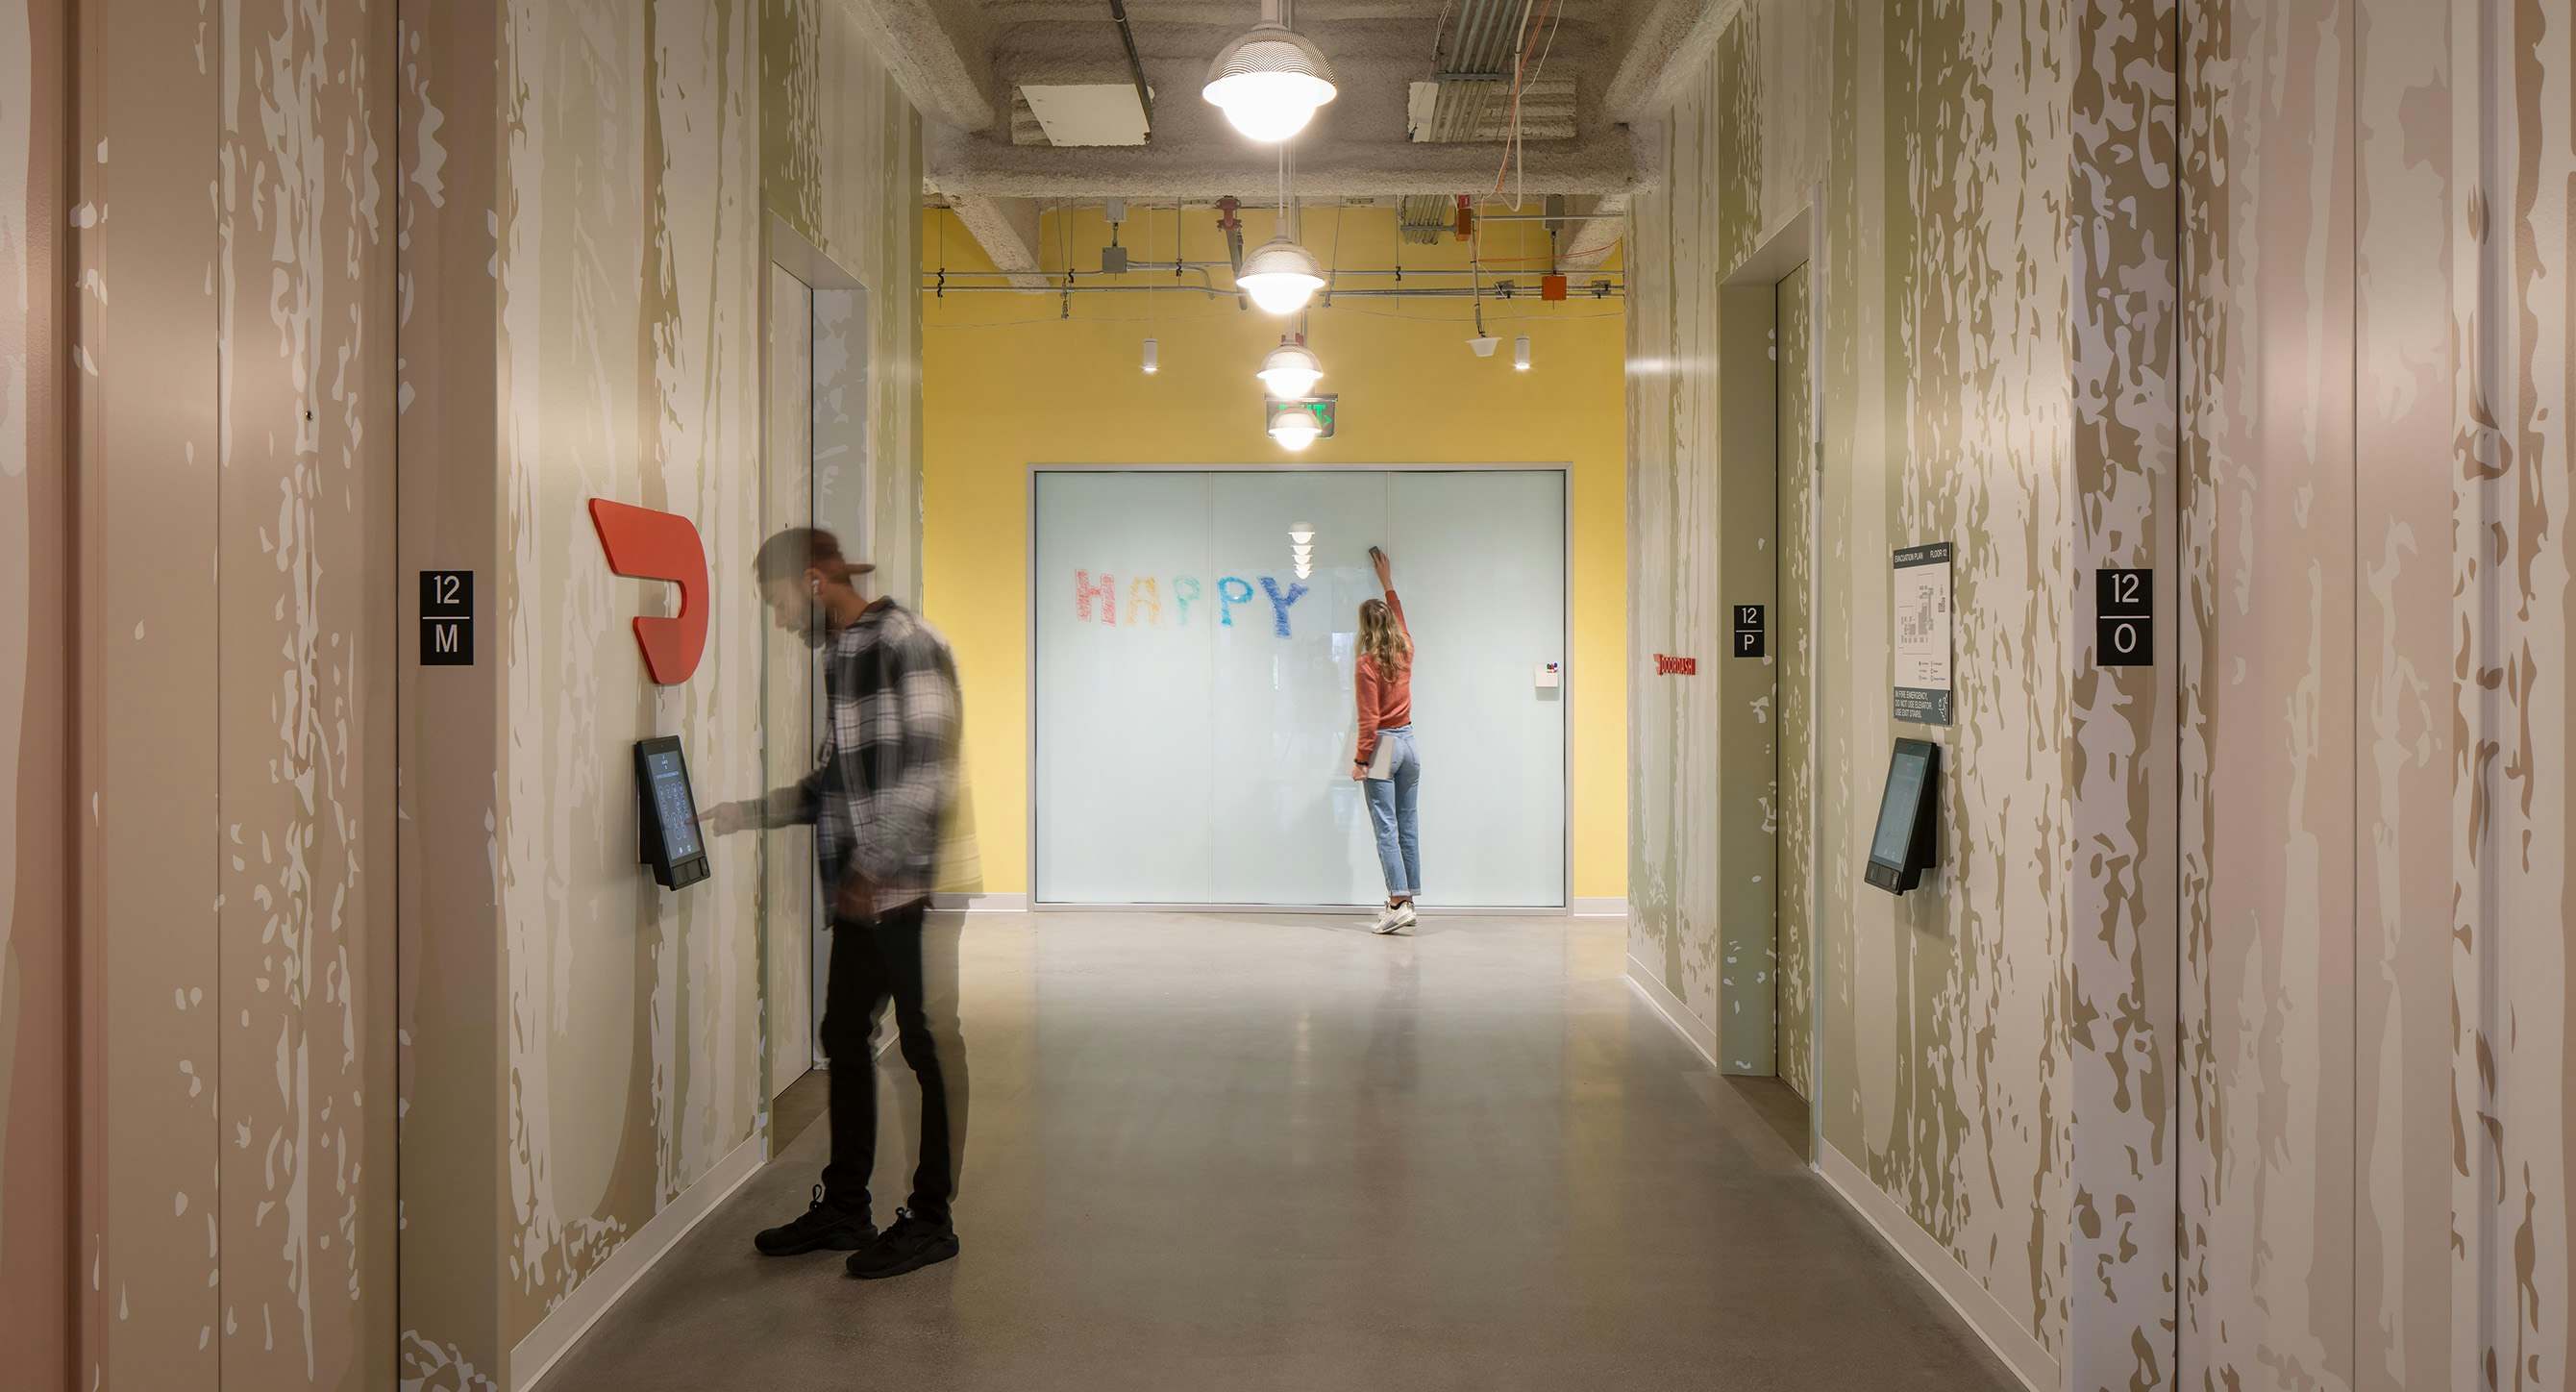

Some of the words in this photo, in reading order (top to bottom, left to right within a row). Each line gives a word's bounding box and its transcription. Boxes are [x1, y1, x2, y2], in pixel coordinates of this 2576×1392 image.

[1914, 551, 1924, 560] PLAN
[1929, 549, 1943, 559] FLOOR
[433, 575, 459, 604] 12
[2112, 573, 2140, 603] 12
[1075, 568, 1308, 639] HAPPY
[1742, 607, 1757, 624] 12
[435, 624, 458, 653] M
[1744, 634, 1754, 651] P
[1661, 657, 1696, 675] DOORDASH
[1895, 699, 1900, 708] DO
